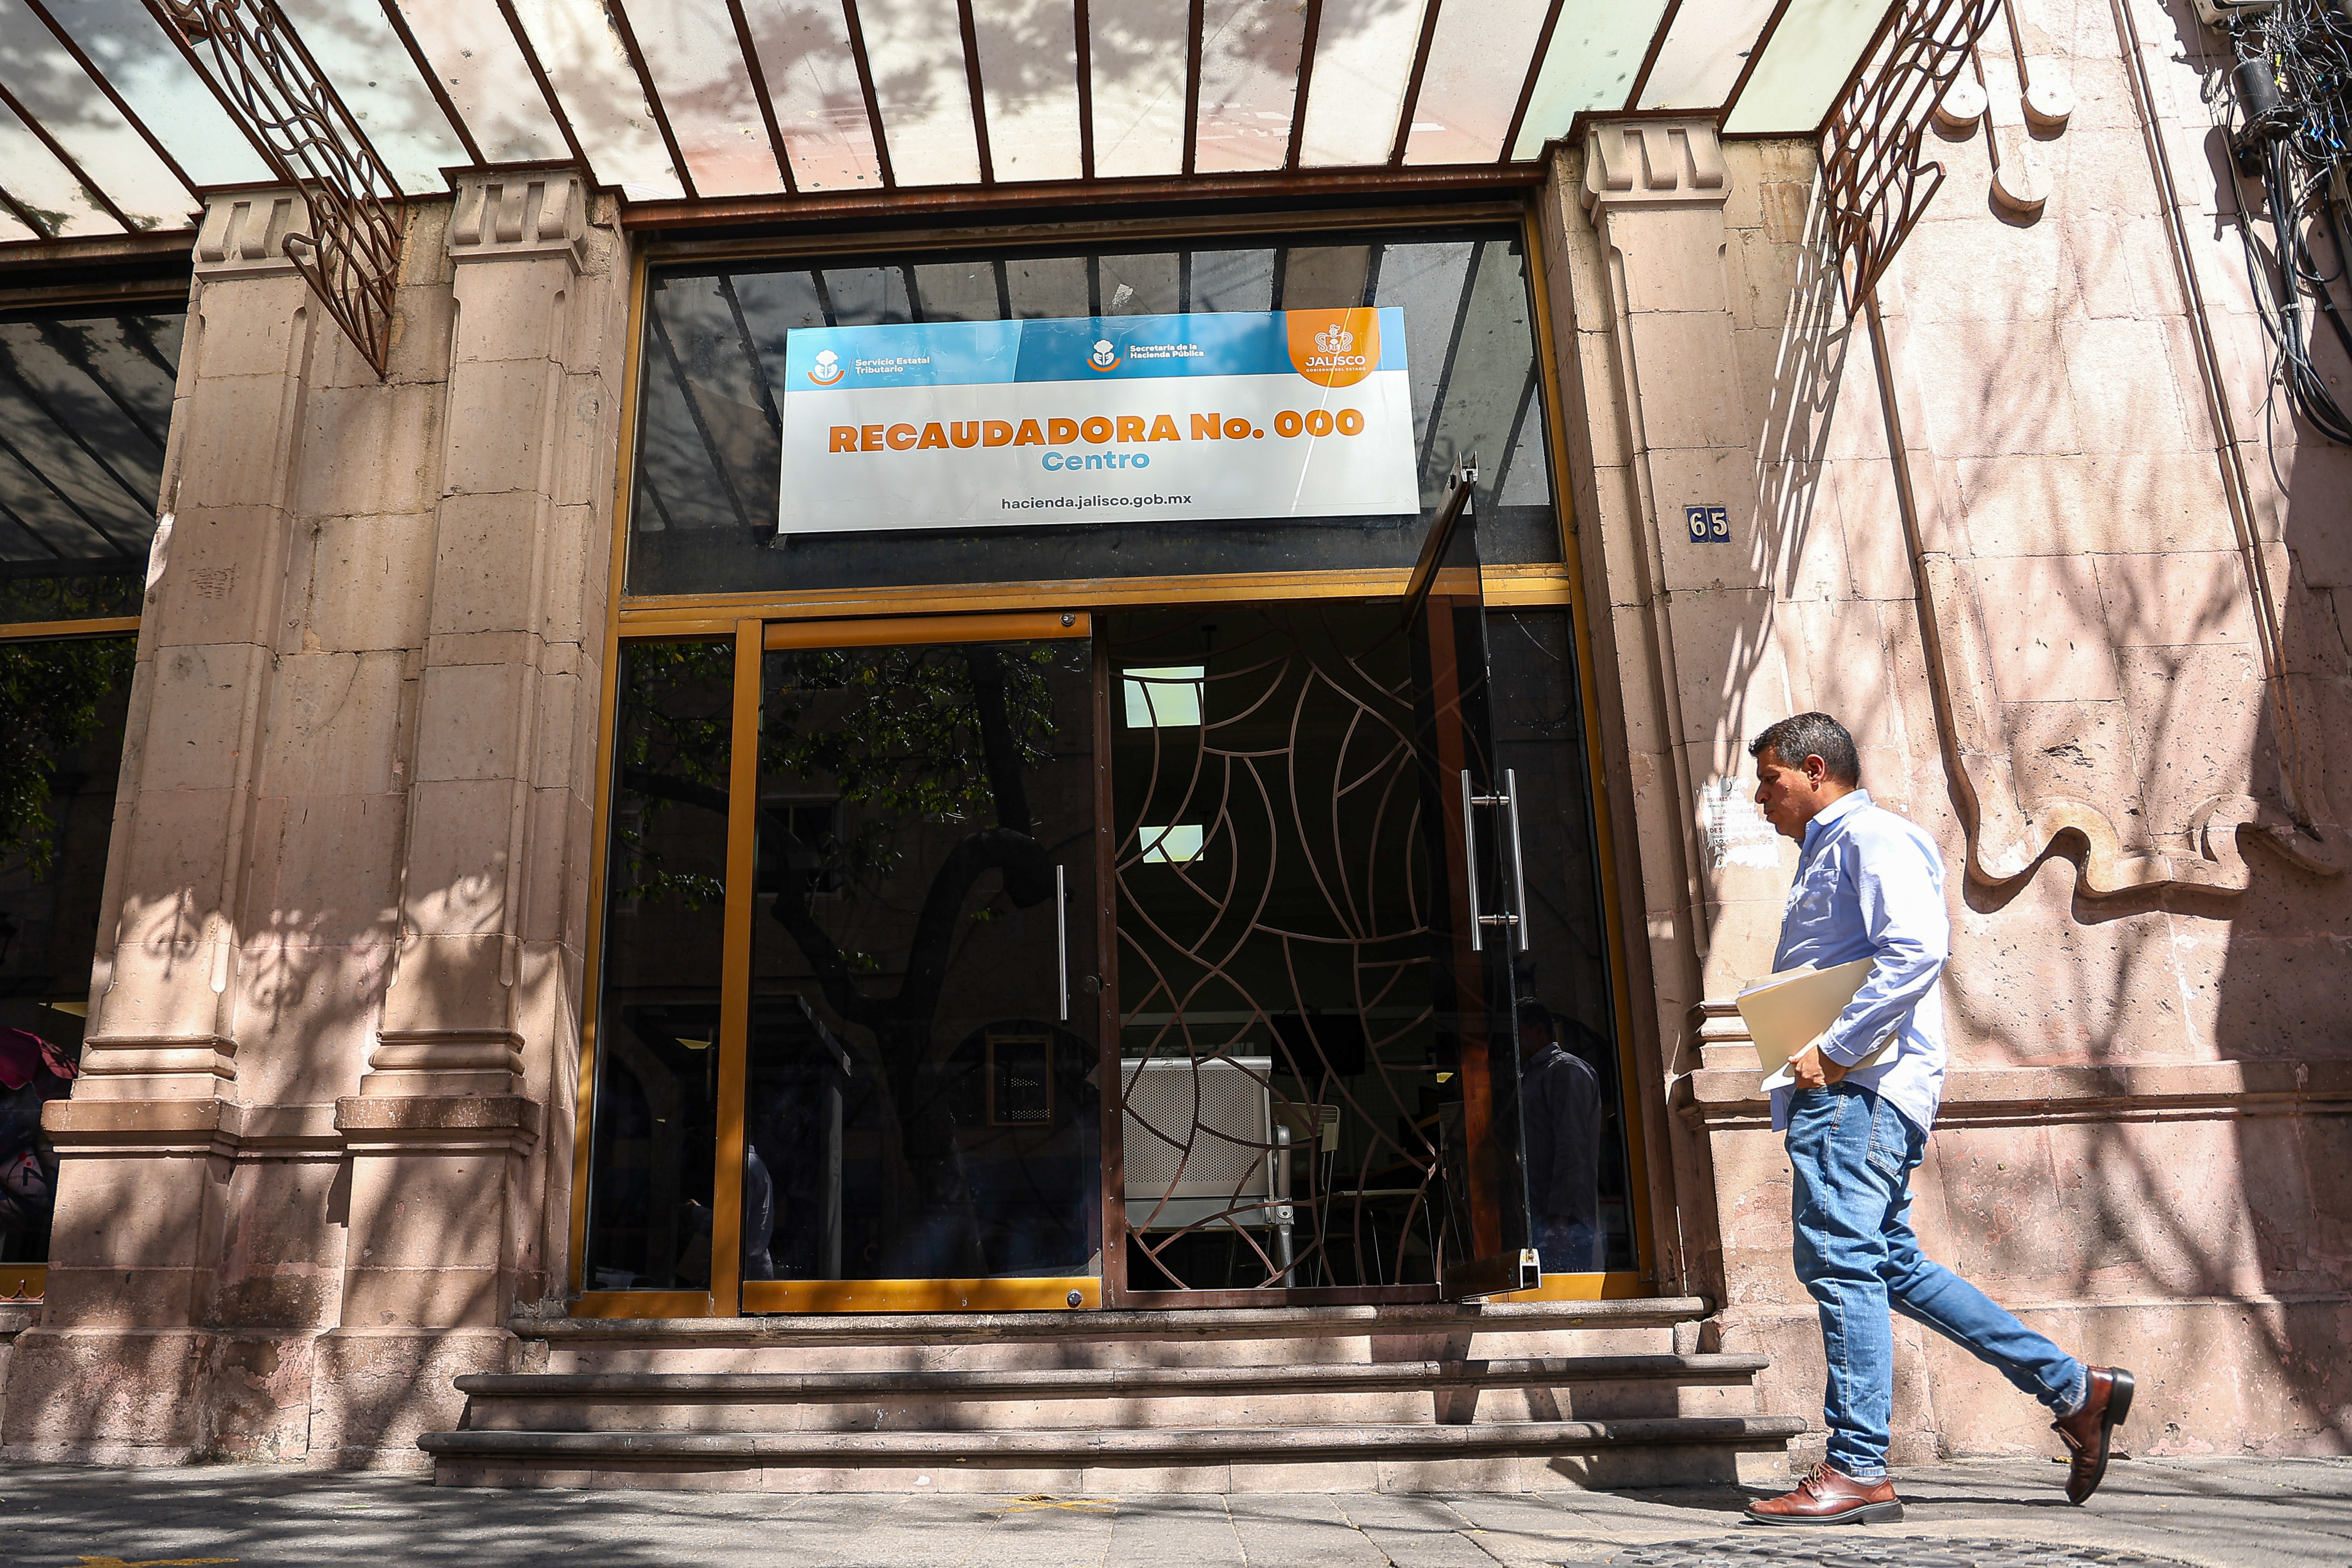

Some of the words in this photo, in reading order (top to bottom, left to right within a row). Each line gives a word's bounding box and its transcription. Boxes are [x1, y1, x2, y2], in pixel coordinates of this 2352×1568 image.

[1129, 344, 1175, 352] Secretaría
[855, 358, 894, 366] Servicio
[897, 356, 930, 364] Estatal
[1305, 355, 1366, 366] JALISCO
[855, 365, 904, 374] Tributario
[829, 414, 1180, 453] RECAUDADORA
[1190, 412, 1265, 440] No.
[1273, 408, 1365, 438] 000
[1042, 450, 1150, 472] Centro
[1001, 493, 1193, 510] hacienda.jalisco.gob.mx
[1690, 512, 1727, 536] 65
